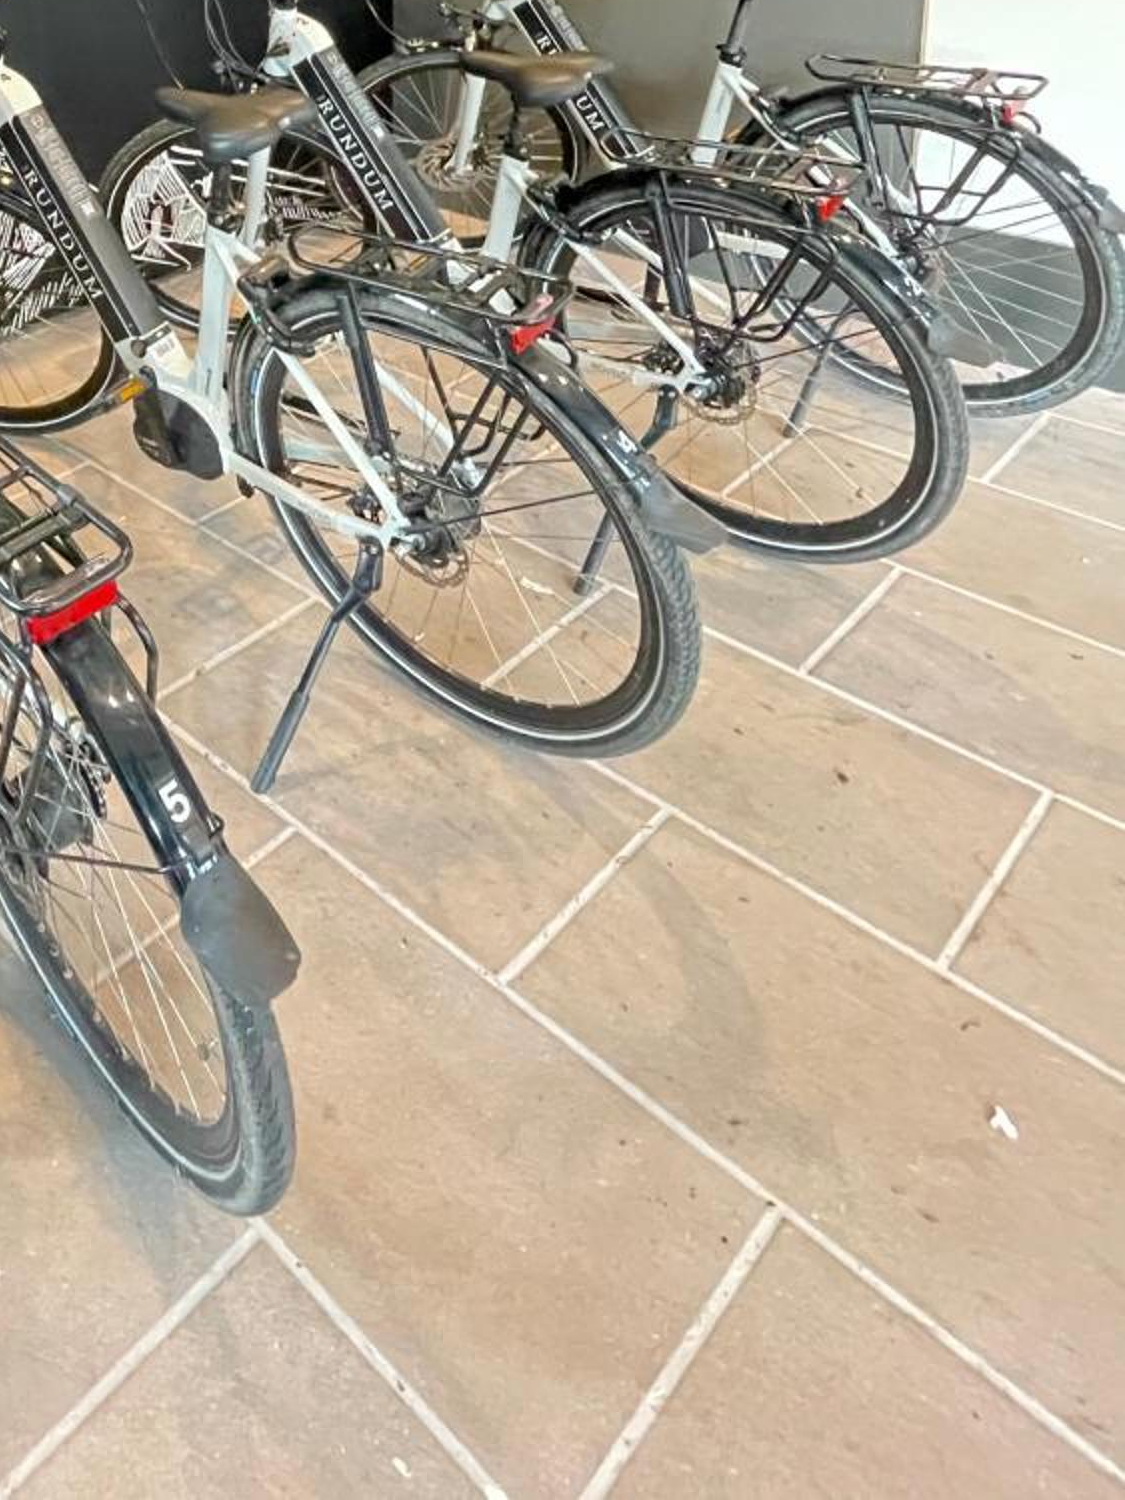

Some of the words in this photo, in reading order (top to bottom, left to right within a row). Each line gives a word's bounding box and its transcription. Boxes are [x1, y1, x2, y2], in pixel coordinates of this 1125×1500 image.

[318, 98, 394, 211] RUNDUM
[24, 169, 104, 299] RUNDUM
[158, 778, 191, 823] 5
